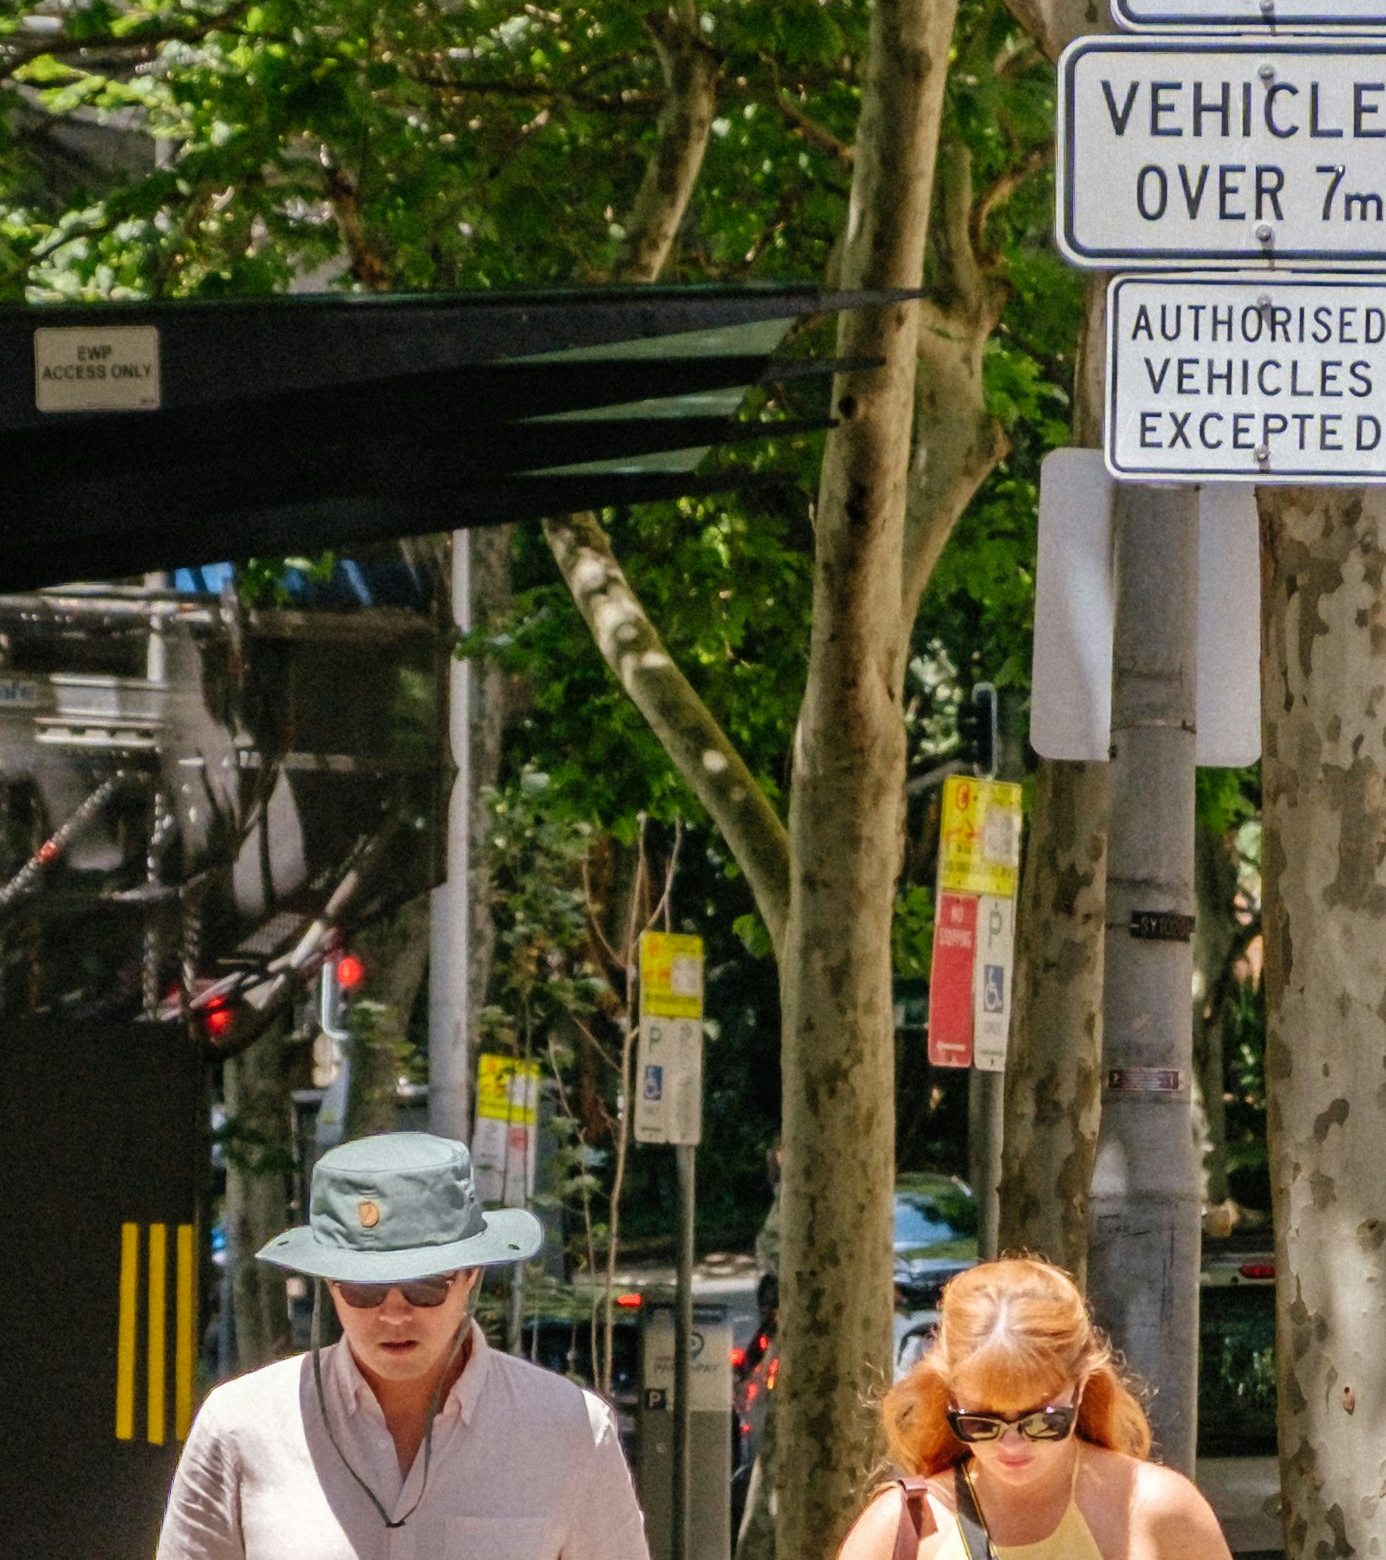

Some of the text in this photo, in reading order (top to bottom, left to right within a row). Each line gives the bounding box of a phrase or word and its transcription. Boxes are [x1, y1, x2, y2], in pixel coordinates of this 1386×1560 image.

[1136, 163, 1385, 223] OVER 7m
[42, 363, 152, 380] ACCESS ONLY
[77, 345, 112, 361] EWP
[1143, 358, 1374, 399] VEHICLES
[1138, 412, 1383, 452] EXCEPTED
